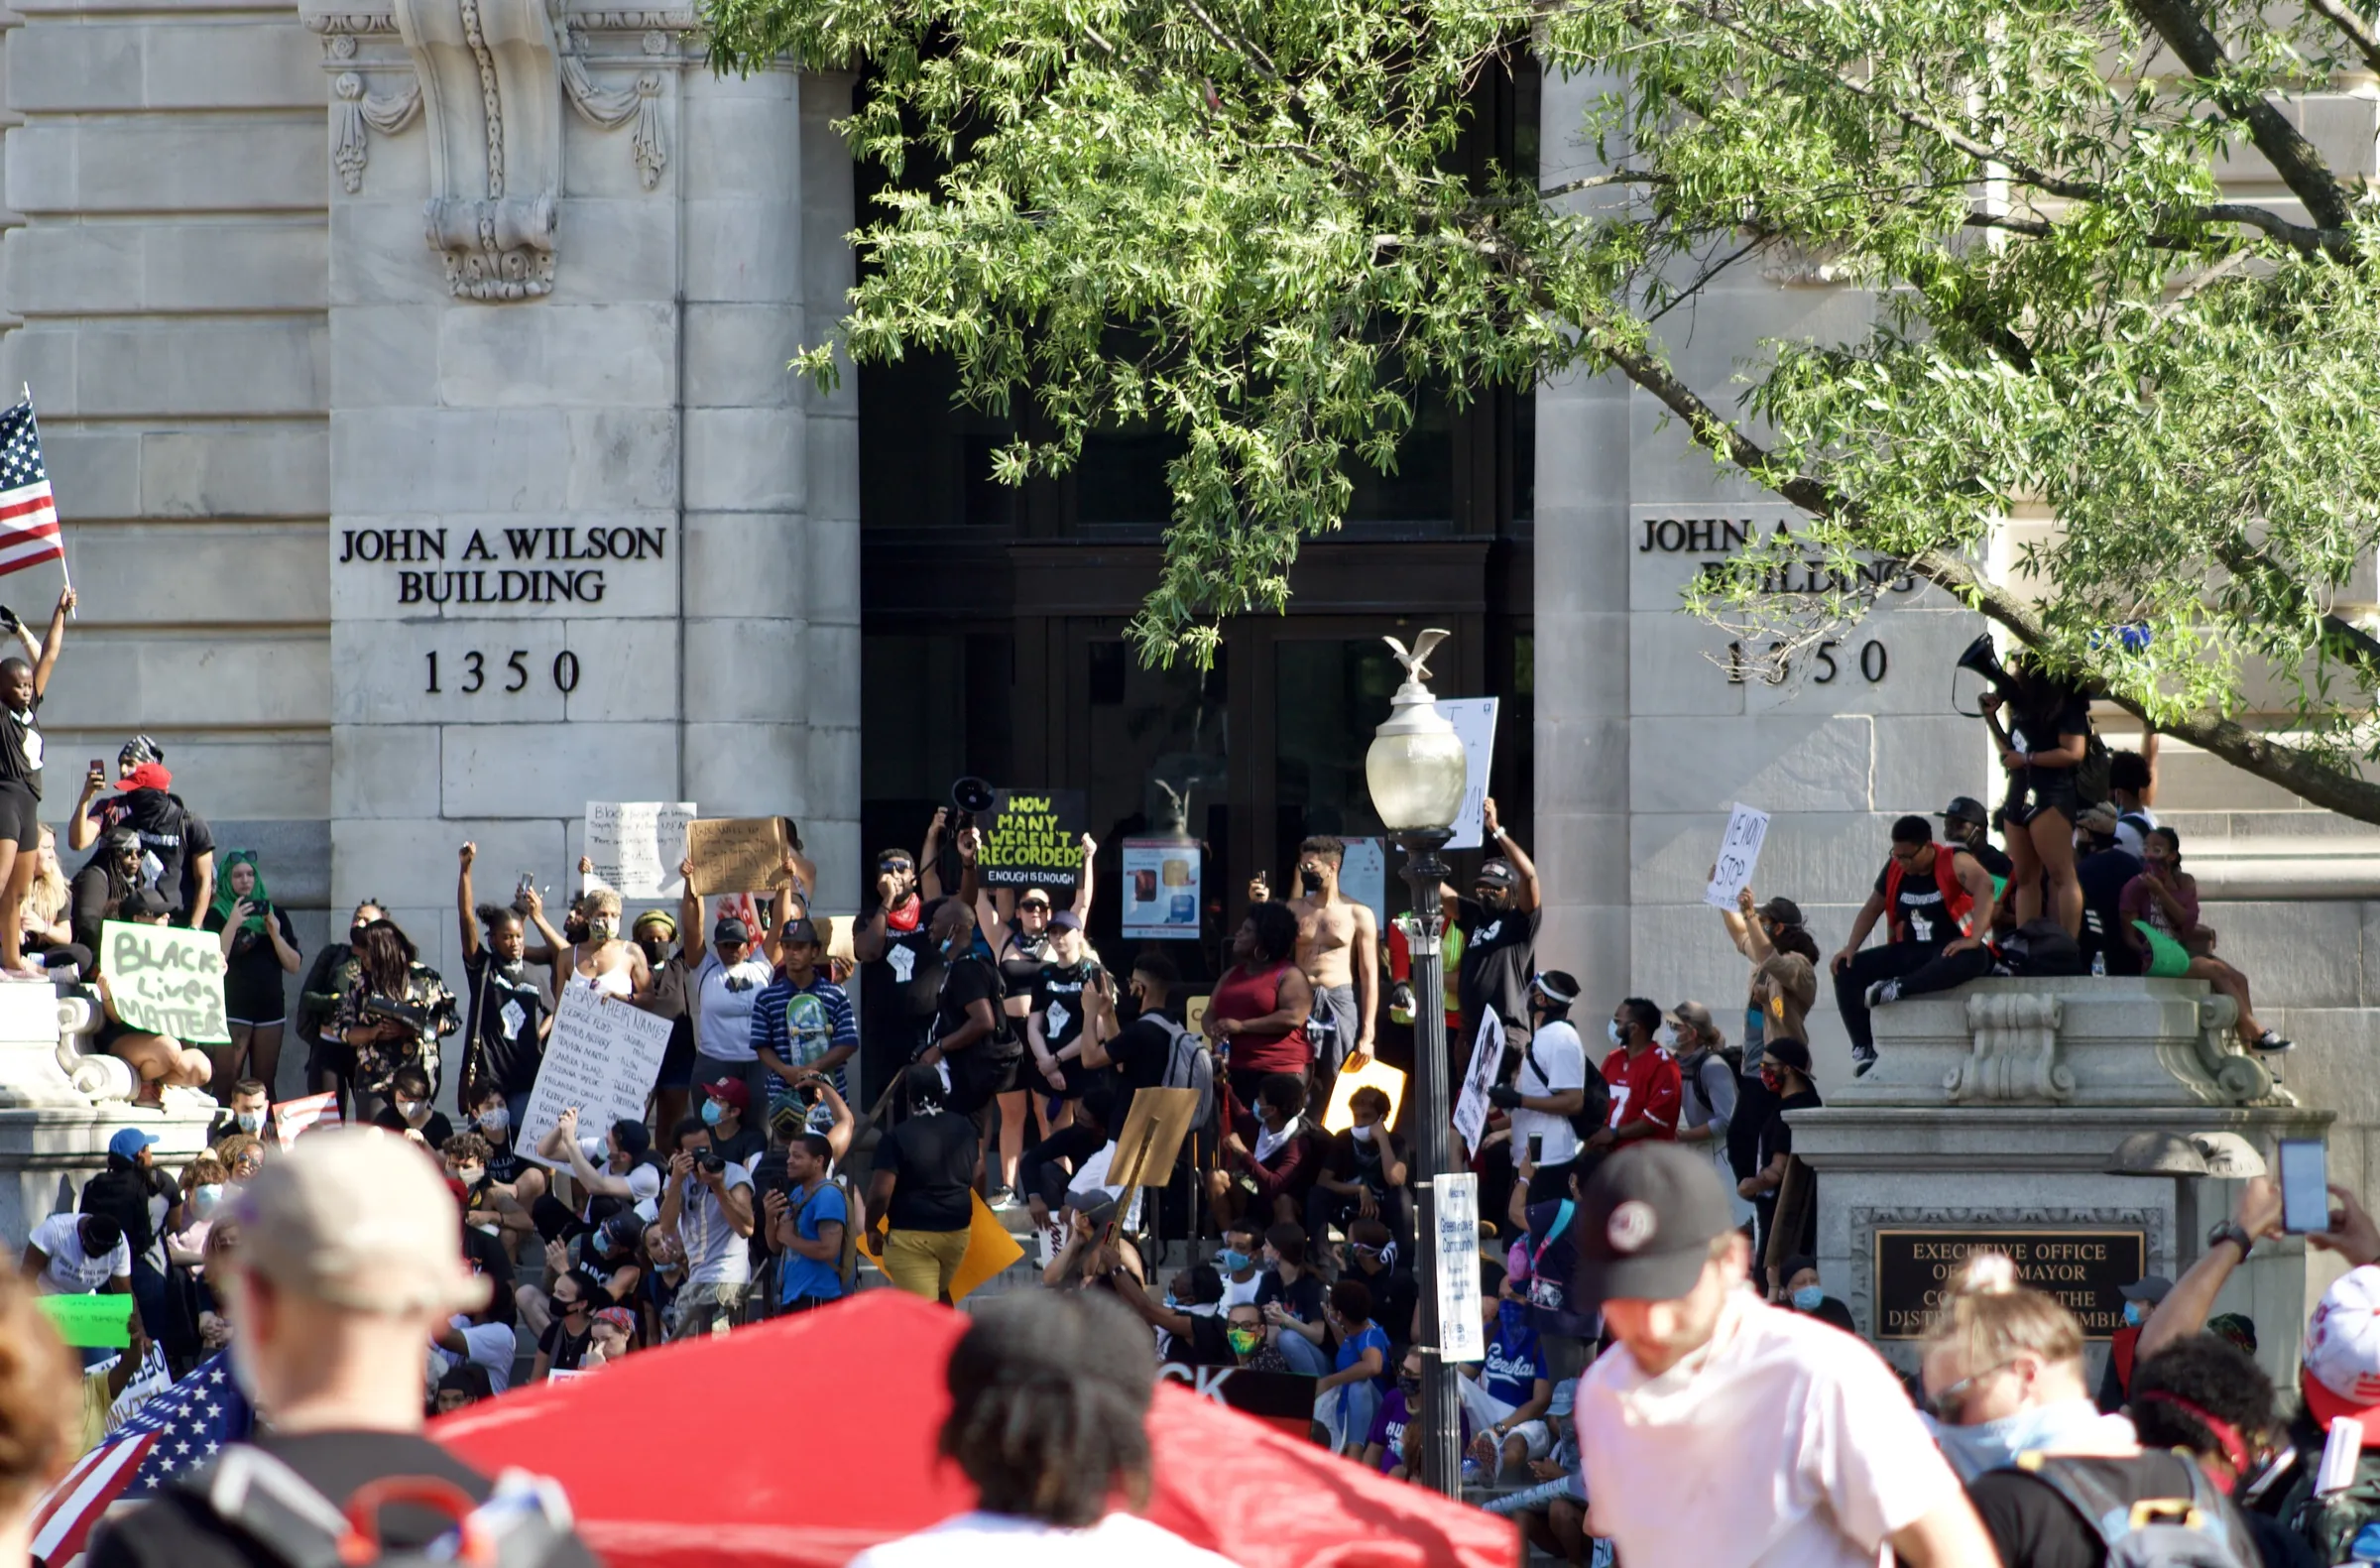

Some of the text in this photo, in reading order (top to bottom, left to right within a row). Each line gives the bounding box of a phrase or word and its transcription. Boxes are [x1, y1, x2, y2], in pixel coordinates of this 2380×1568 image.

[340, 527, 666, 562] JOHN A. WILSON
[1639, 520, 1751, 552] JOHN
[398, 570, 606, 603] BUILDING
[425, 651, 580, 693] 1350
[1727, 641, 1887, 683] 1350
[1009, 796, 1050, 812] HOW
[998, 814, 1058, 831] MANY
[988, 829, 1071, 847] WEREN'T
[978, 846, 1084, 868] RECORDED?
[989, 871, 1075, 884] ENOUGH IS ENOUGH
[1716, 854, 1745, 895] STOP
[114, 931, 217, 976] BLACK
[118, 997, 229, 1039] MATTER
[562, 1006, 590, 1024] GEORGE
[573, 988, 667, 1040] SAY THEIR NAMES
[584, 1046, 610, 1062] MARTIN
[1609, 1084, 1631, 1129] 7
[1440, 1216, 1456, 1233] Green
[1913, 1244, 2106, 1260] EXECUTIVE OFFICE
[2014, 1265, 2086, 1280] MAYOR
[2058, 1291, 2096, 1306] THE
